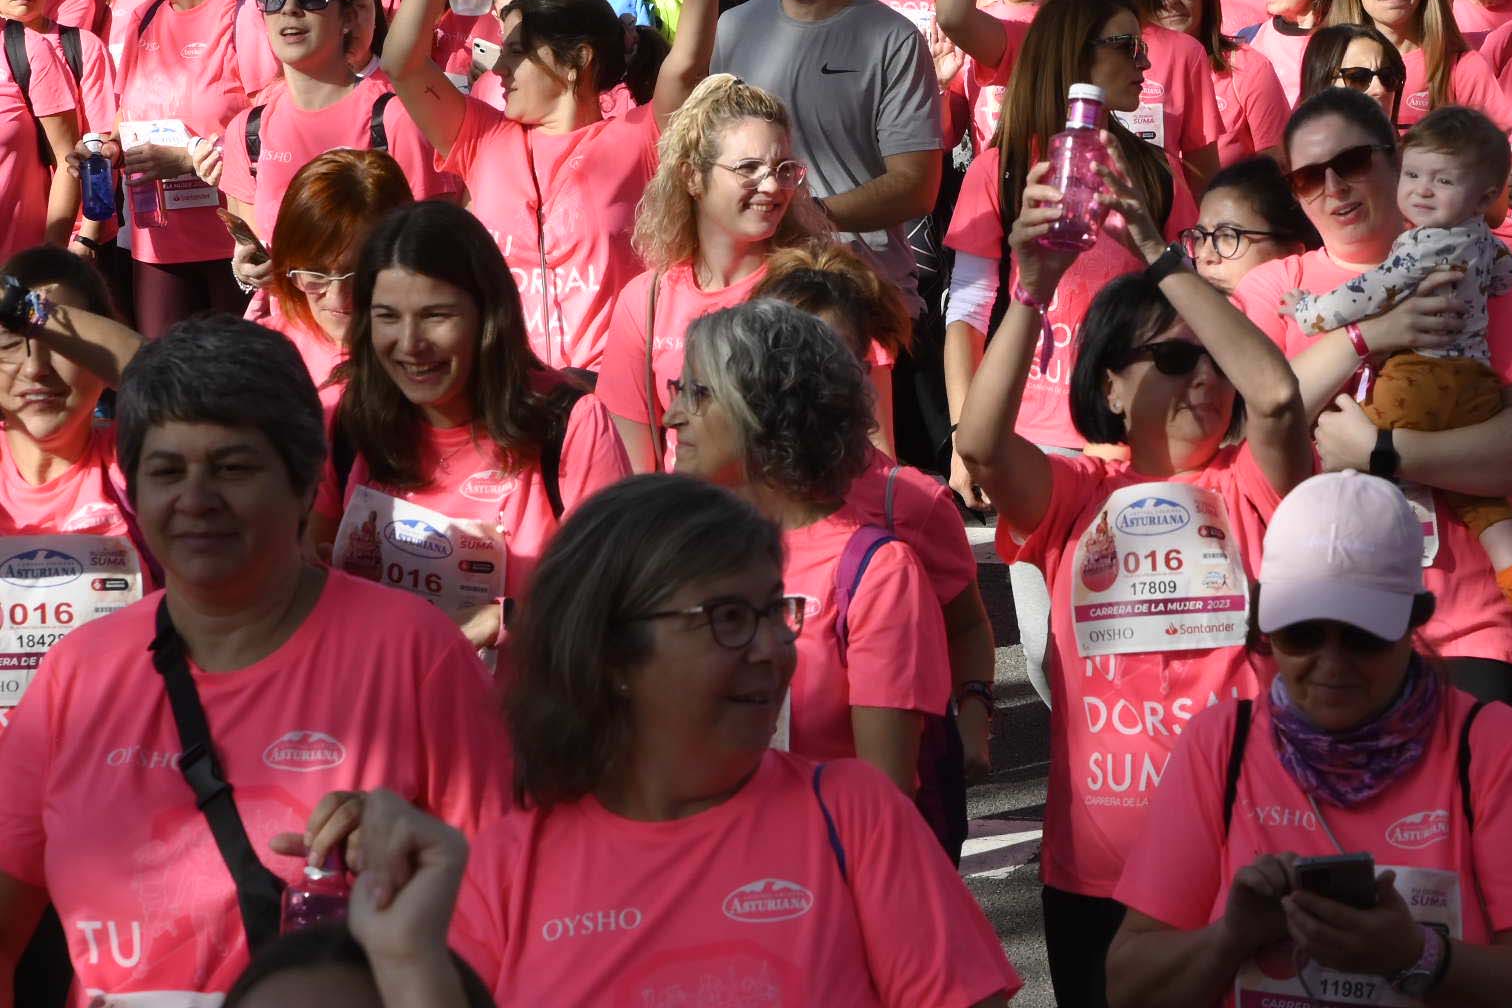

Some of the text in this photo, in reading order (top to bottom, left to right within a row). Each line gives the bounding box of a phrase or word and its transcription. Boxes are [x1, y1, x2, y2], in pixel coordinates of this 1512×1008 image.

[1120, 514, 1184, 529] ASTURIANA
[5, 564, 77, 578] ASTURIANA
[90, 557, 126, 567] SUMA
[1123, 548, 1184, 574] 016
[387, 562, 443, 593] 016
[1131, 580, 1177, 596] 17809
[9, 602, 74, 626] 016
[1090, 599, 1231, 617] CARRERA DE LA MUJER 2023
[1089, 622, 1235, 642] OYSHO Santander
[20, 656, 37, 666] DE
[729, 895, 811, 915] ASTURIANA
[1411, 895, 1448, 908] SUMA
[542, 908, 642, 942] OYSHO
[77, 921, 142, 969] TU
[1320, 978, 1377, 999] 11987
